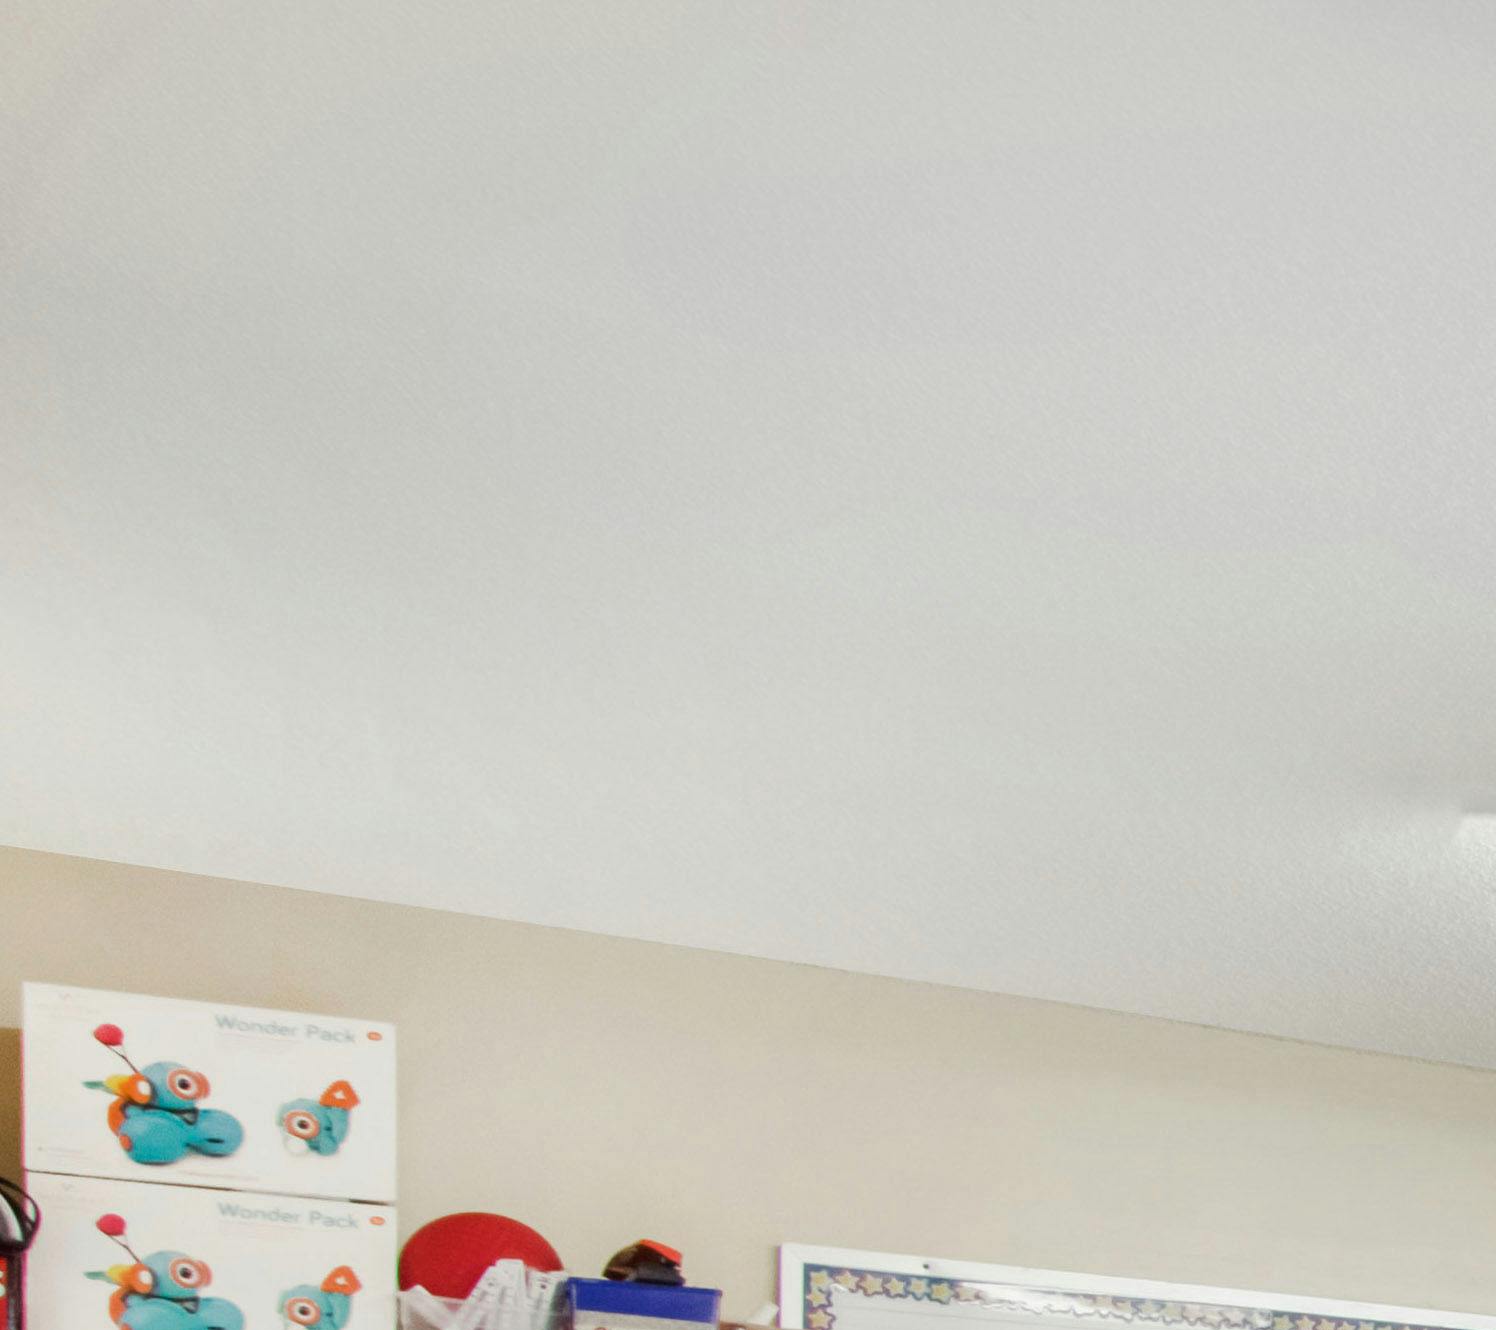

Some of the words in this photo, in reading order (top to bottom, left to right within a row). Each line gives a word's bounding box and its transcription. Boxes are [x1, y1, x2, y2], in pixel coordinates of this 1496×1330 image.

[214, 1013, 299, 1038] Wonder
[305, 1023, 357, 1044] Pack
[217, 1201, 303, 1225] Wonder
[308, 1210, 358, 1231] Pack
